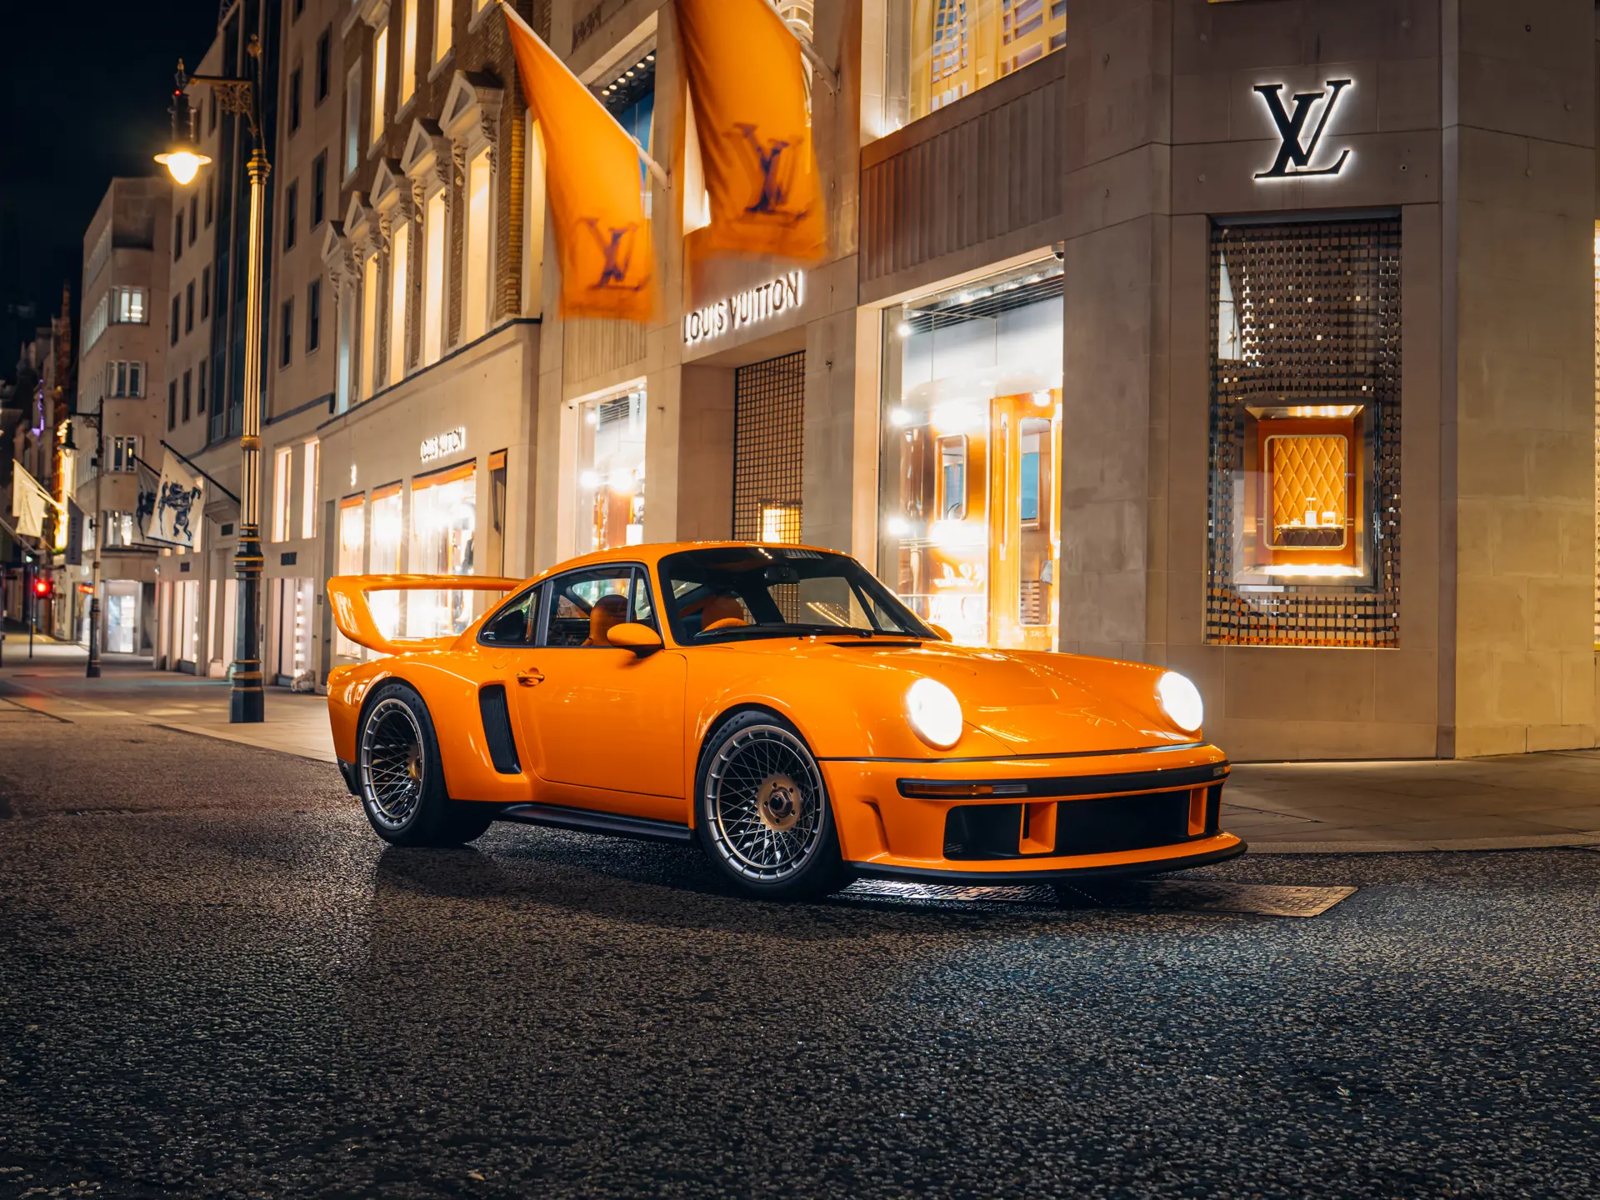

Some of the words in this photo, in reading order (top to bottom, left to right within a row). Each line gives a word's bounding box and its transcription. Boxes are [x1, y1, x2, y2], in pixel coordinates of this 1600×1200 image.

[1253, 78, 1352, 179] LV
[683, 300, 727, 344] LOUIS
[728, 270, 803, 330] VUITTON
